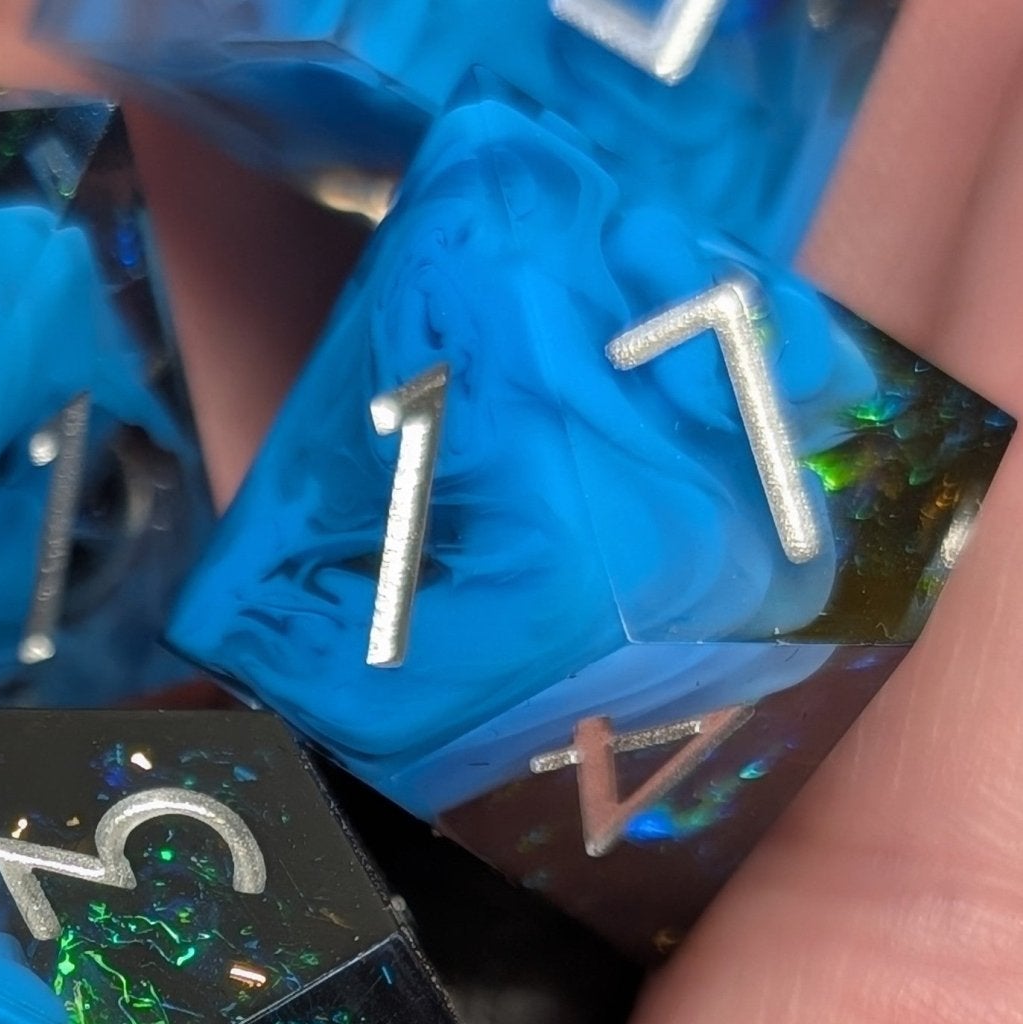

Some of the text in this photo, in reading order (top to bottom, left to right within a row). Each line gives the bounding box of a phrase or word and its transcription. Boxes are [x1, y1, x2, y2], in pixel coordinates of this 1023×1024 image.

[366, 362, 449, 668] 1
[605, 272, 821, 566] 7
[529, 703, 756, 858] 4
